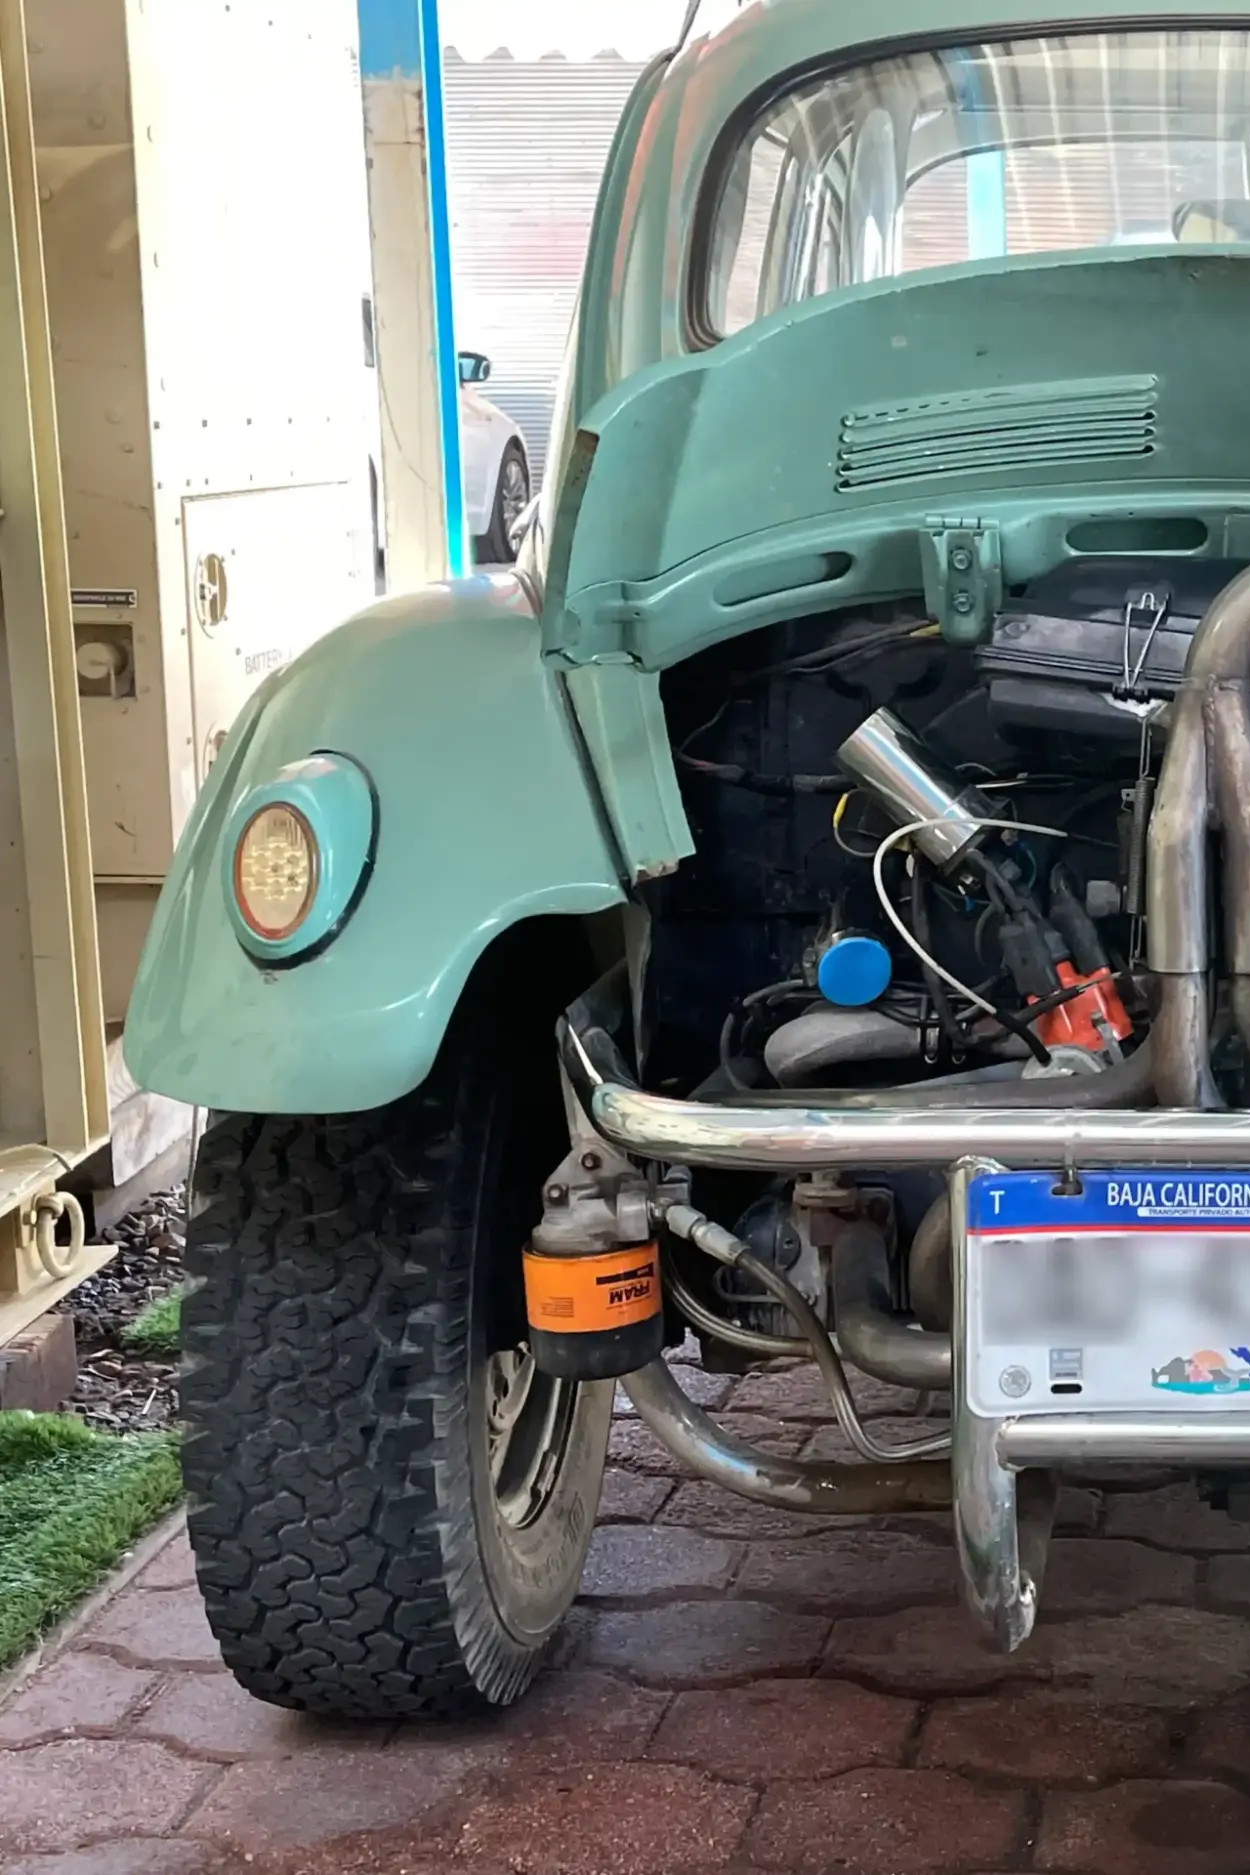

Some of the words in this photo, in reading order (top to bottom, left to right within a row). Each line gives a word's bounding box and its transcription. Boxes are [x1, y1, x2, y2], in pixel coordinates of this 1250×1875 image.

[989, 1190, 1005, 1215] T
[1107, 1182, 1156, 1206] BAJA
[609, 1279, 650, 1304] FRAM
